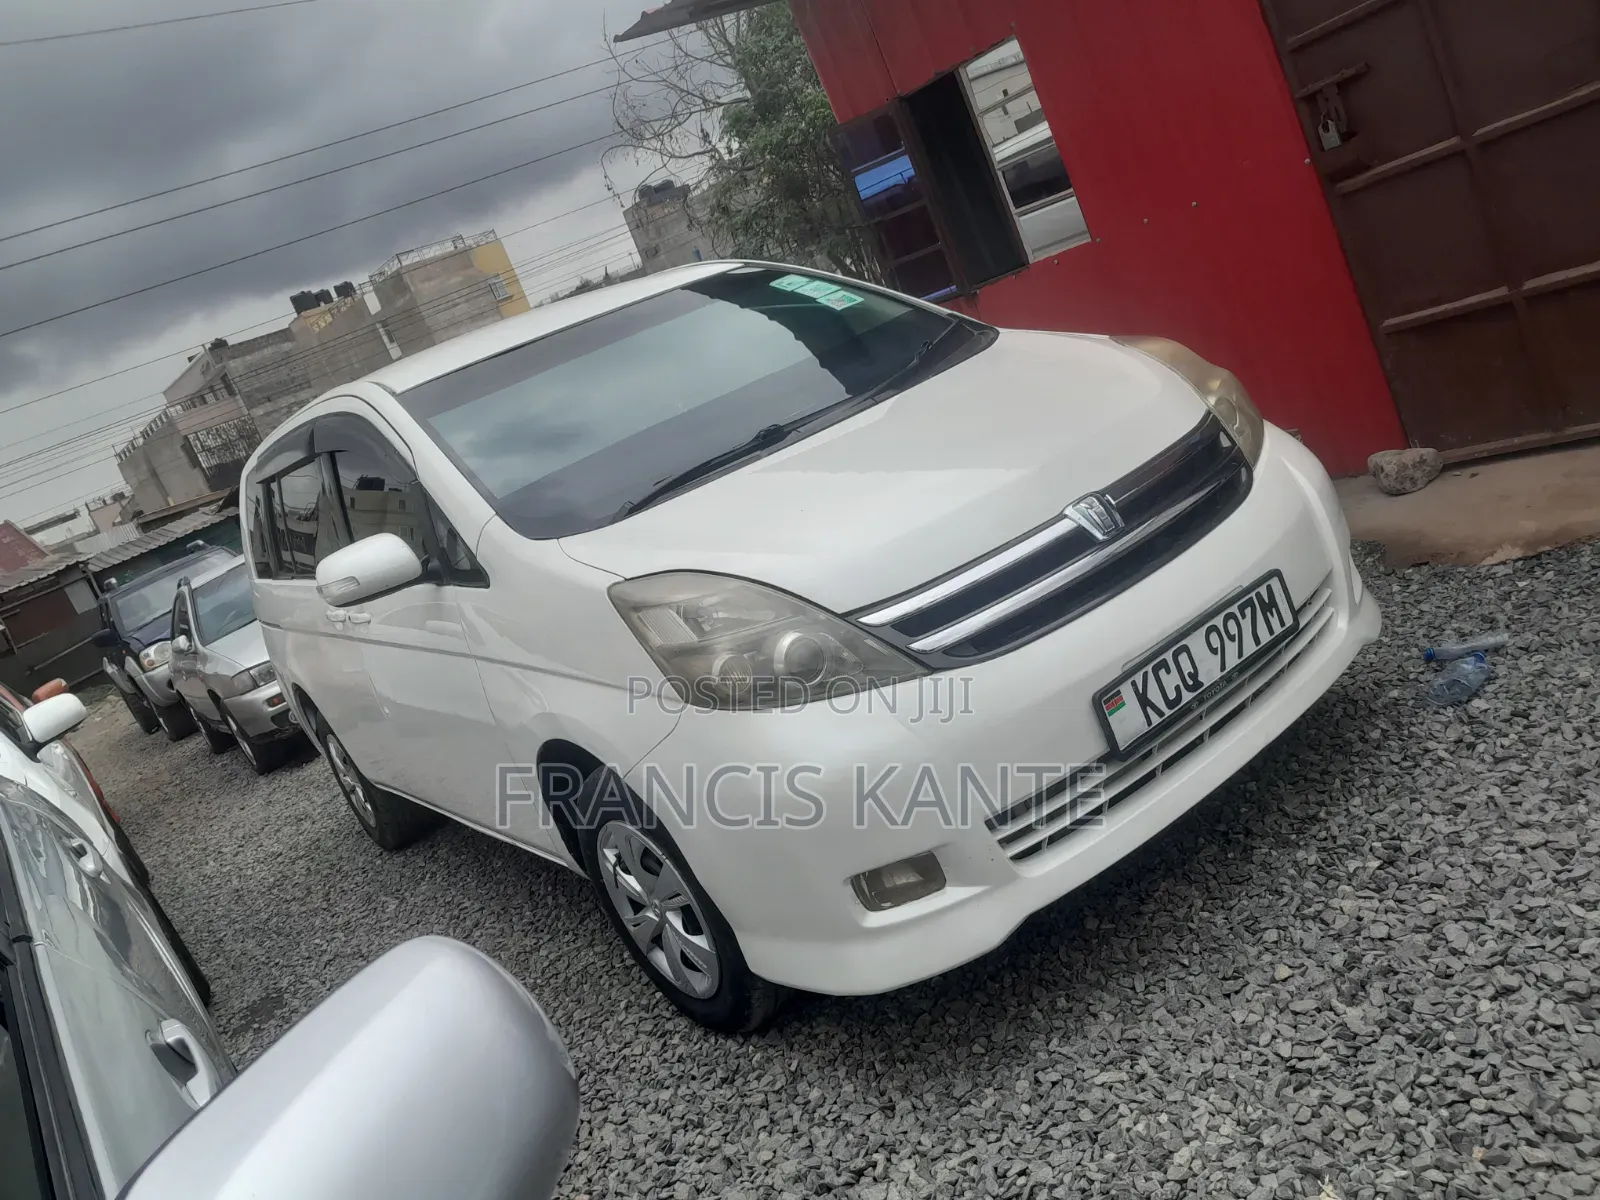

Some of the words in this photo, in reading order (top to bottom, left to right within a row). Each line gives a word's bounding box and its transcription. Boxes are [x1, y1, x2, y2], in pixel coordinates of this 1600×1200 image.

[1131, 643, 1204, 727] KCQ
[1204, 583, 1286, 673] 997M
[1203, 680, 1229, 701] TOYOTA
